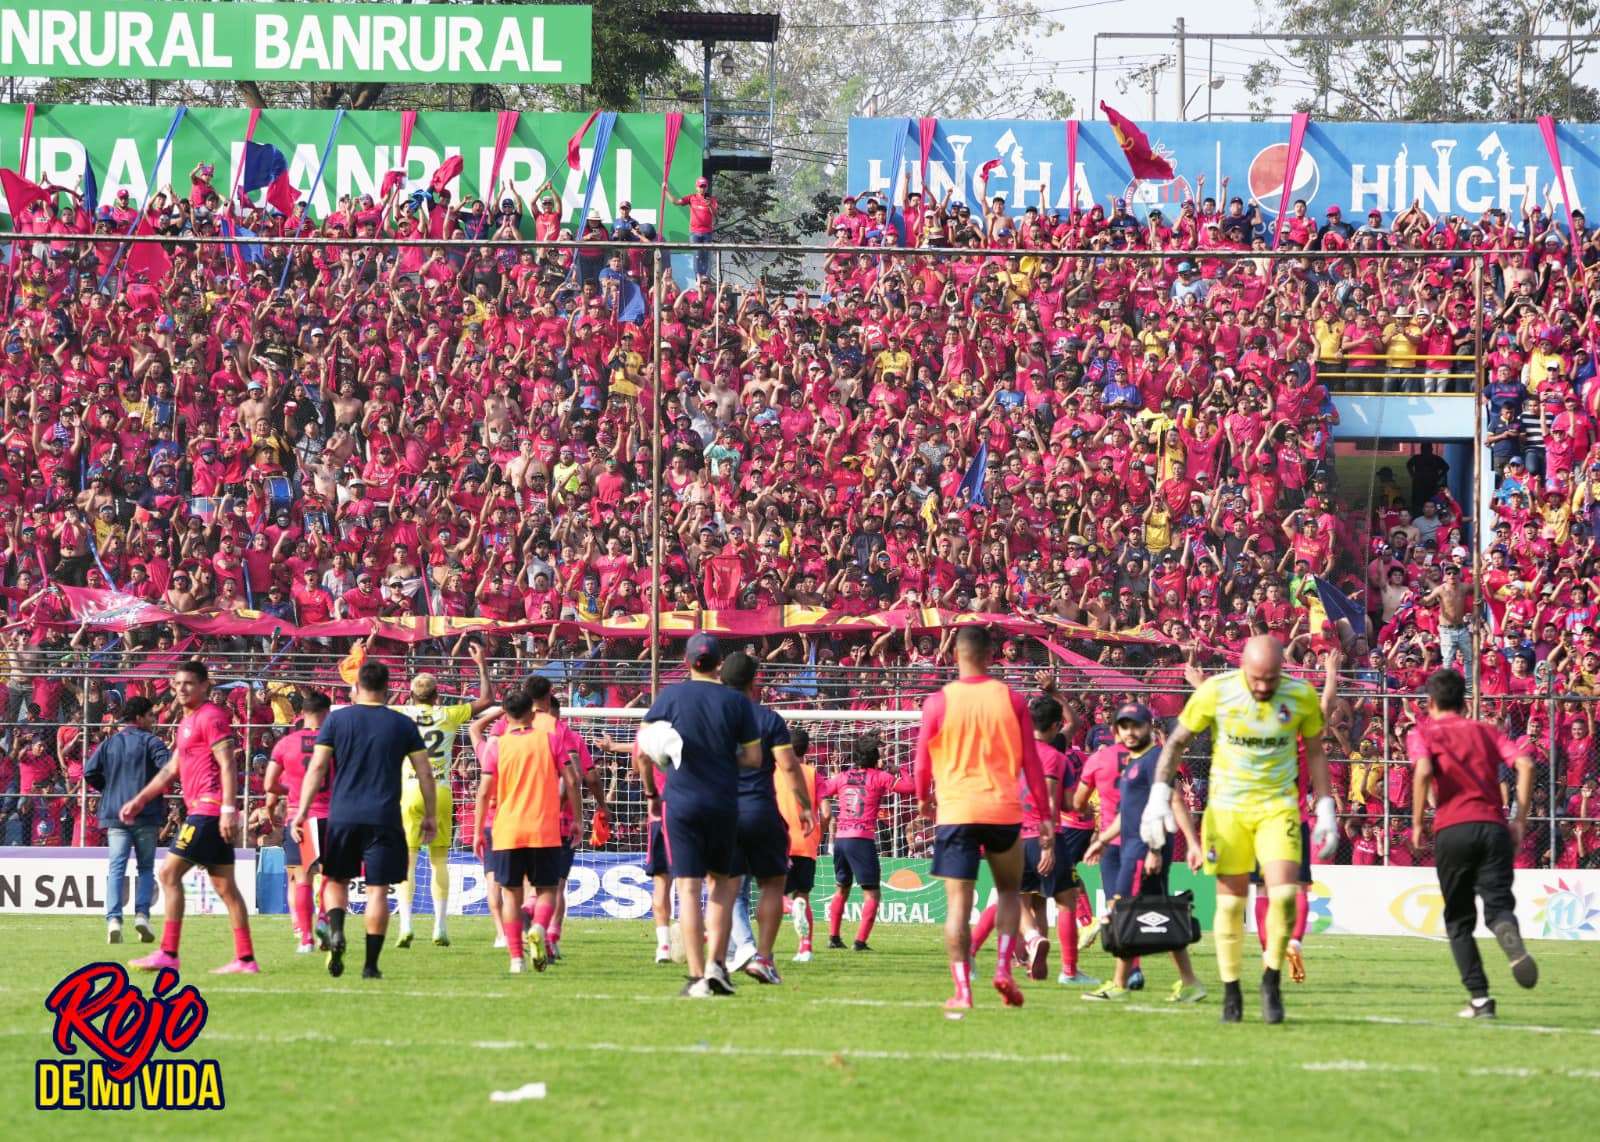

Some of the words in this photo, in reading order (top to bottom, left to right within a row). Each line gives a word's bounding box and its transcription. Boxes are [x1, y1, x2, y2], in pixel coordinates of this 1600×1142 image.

[1, 9, 232, 67] NRURAL
[256, 14, 562, 72] BANRURAL
[230, 141, 656, 225] ANURAL
[868, 158, 1096, 209] HINCHA
[1350, 160, 1586, 213] HINCHA
[431, 863, 676, 919] PPS
[824, 902, 935, 924] ANURAL
